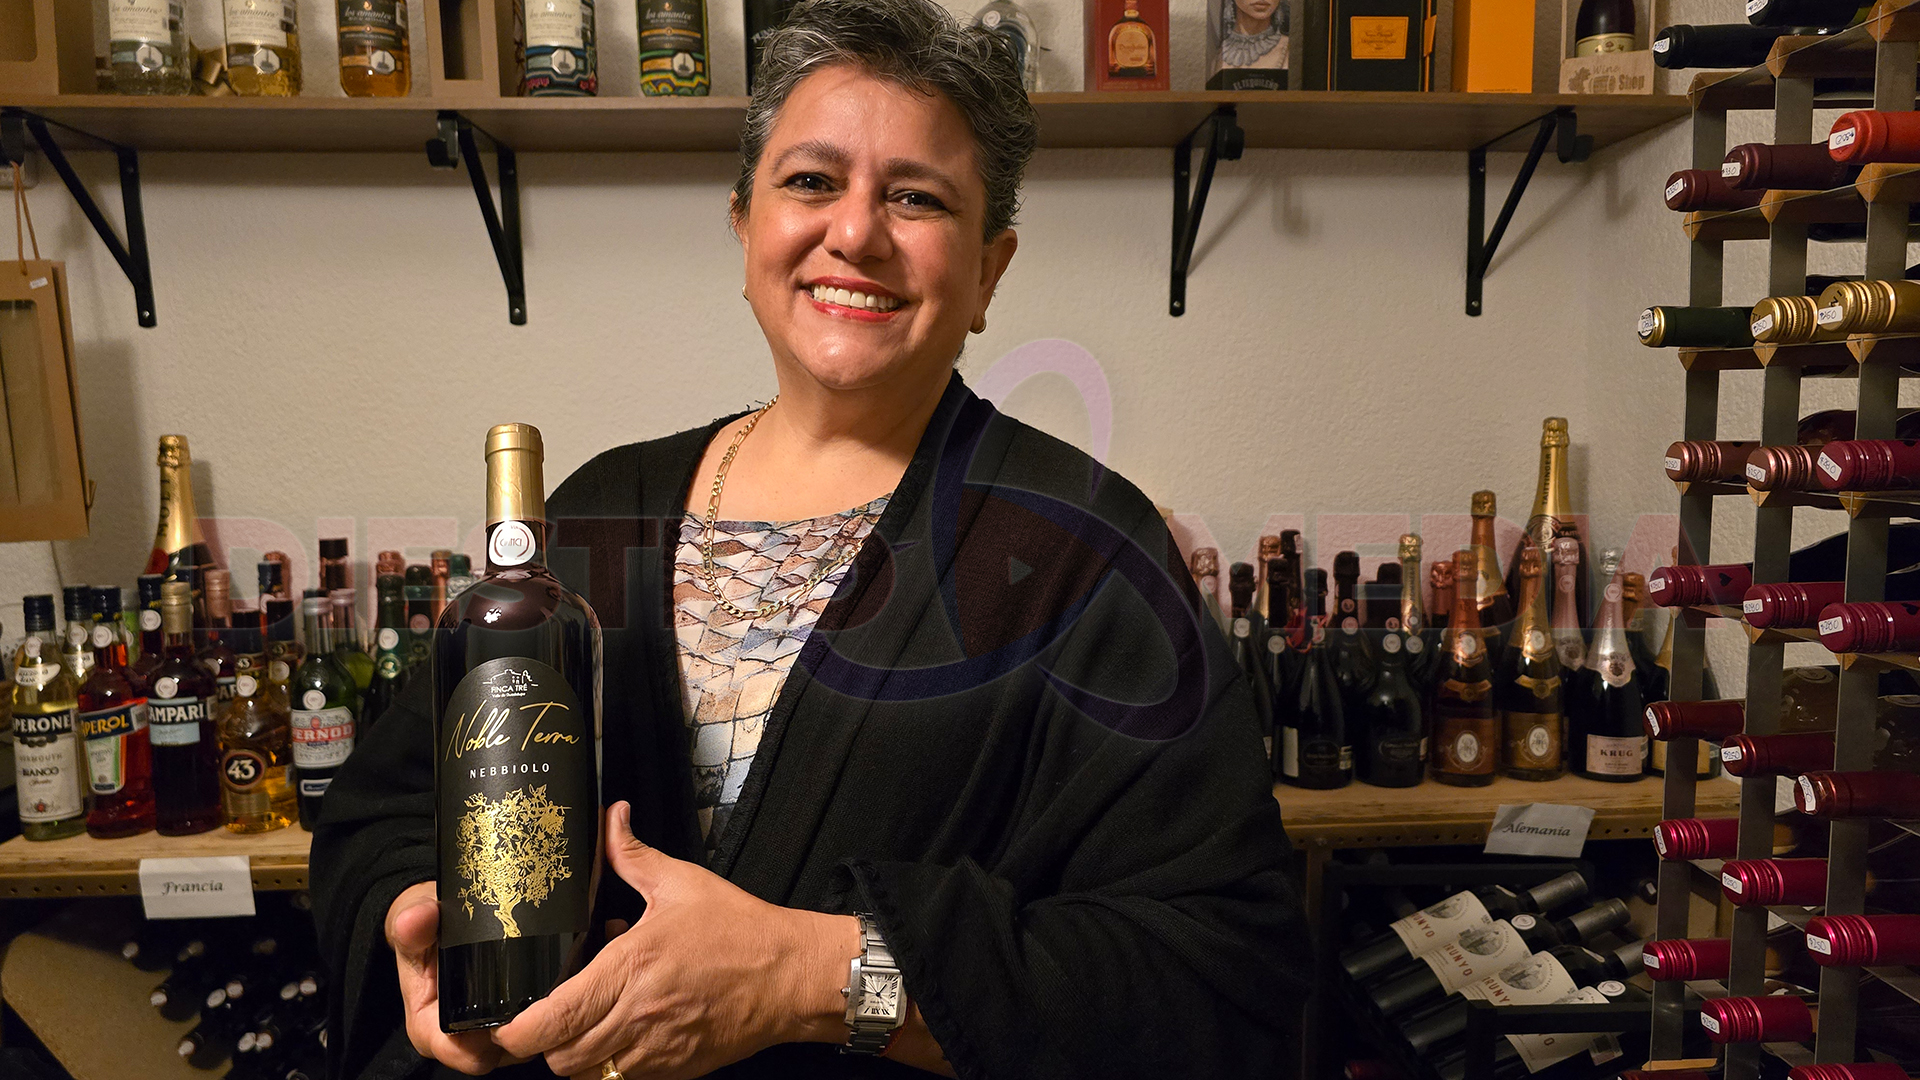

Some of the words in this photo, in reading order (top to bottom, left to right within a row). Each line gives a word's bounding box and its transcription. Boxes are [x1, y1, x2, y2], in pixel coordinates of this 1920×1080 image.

[1619, 74, 1646, 91] Shop
[491, 685, 513, 693] FINCA
[515, 683, 527, 691] TRÉ
[13, 713, 71, 733] PERONE
[445, 700, 510, 761] Noble
[519, 701, 580, 752] Terra
[1600, 749, 1634, 757] KRUG
[227, 759, 256, 780] 43
[469, 763, 550, 779] NEBBIOLO
[1502, 821, 1571, 837] Alemania
[161, 880, 223, 896] Francia
[1809, 937, 1827, 952] $250
